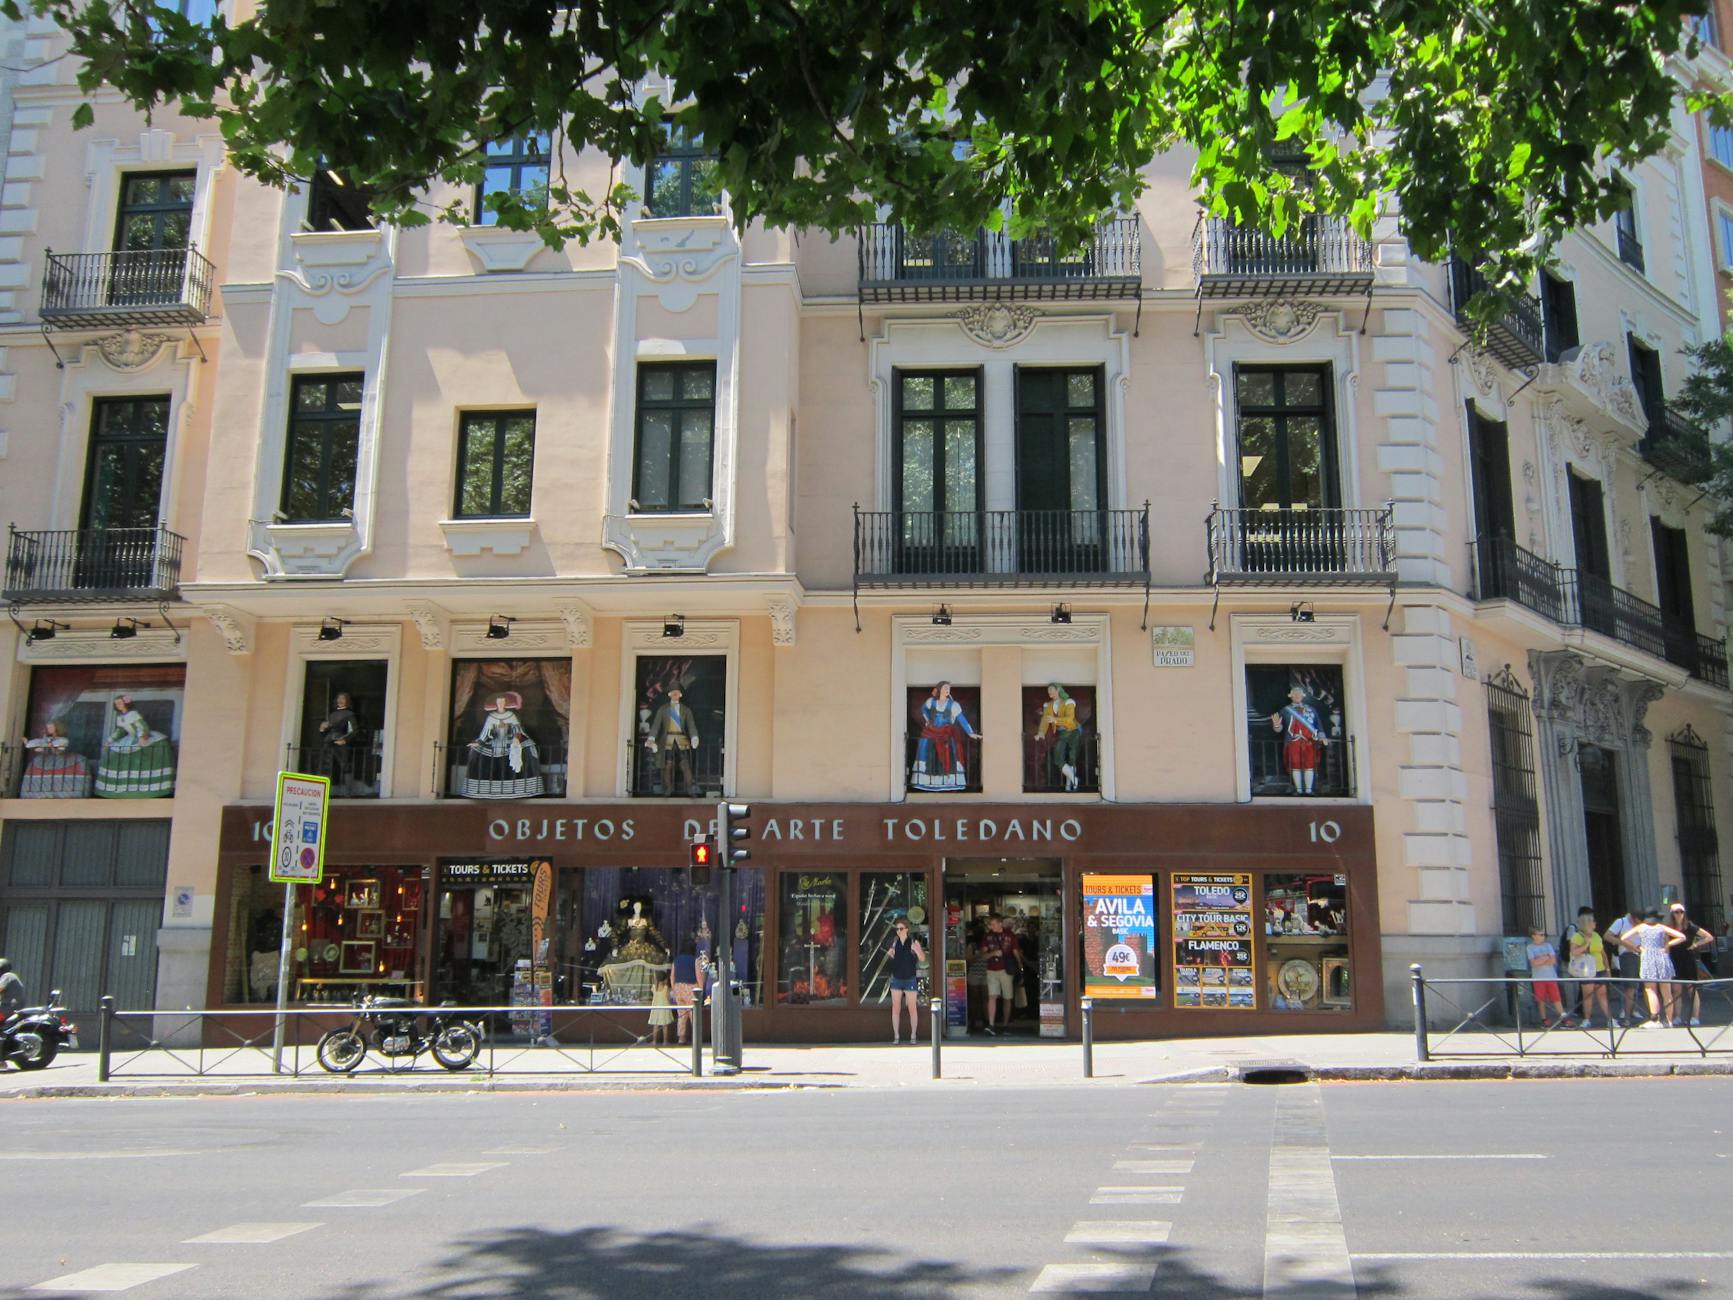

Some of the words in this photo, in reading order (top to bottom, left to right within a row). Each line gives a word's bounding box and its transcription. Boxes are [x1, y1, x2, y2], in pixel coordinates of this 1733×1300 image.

[1160, 657, 1188, 665] PRADO
[488, 818, 636, 841] OBJETOS
[761, 818, 844, 841] ARTE
[884, 818, 1083, 842] TOLEDANO
[1309, 820, 1341, 843] 10
[449, 864, 480, 874] TOURS
[482, 864, 490, 874] &
[492, 864, 528, 874] TICKETS
[1085, 885, 1107, 894] TOURS
[1115, 885, 1142, 895] TICKETS
[1194, 886, 1230, 895] TOLEDO
[1095, 898, 1145, 914] AVILA
[1087, 914, 1098, 927] &
[1101, 914, 1155, 927] SEGOVIA
[1177, 914, 1196, 922] CITY
[1199, 914, 1222, 922] TOUR
[1223, 914, 1249, 922] BASIC
[1188, 940, 1240, 950] FLAMENCO
[1112, 952, 1131, 963] 49€
